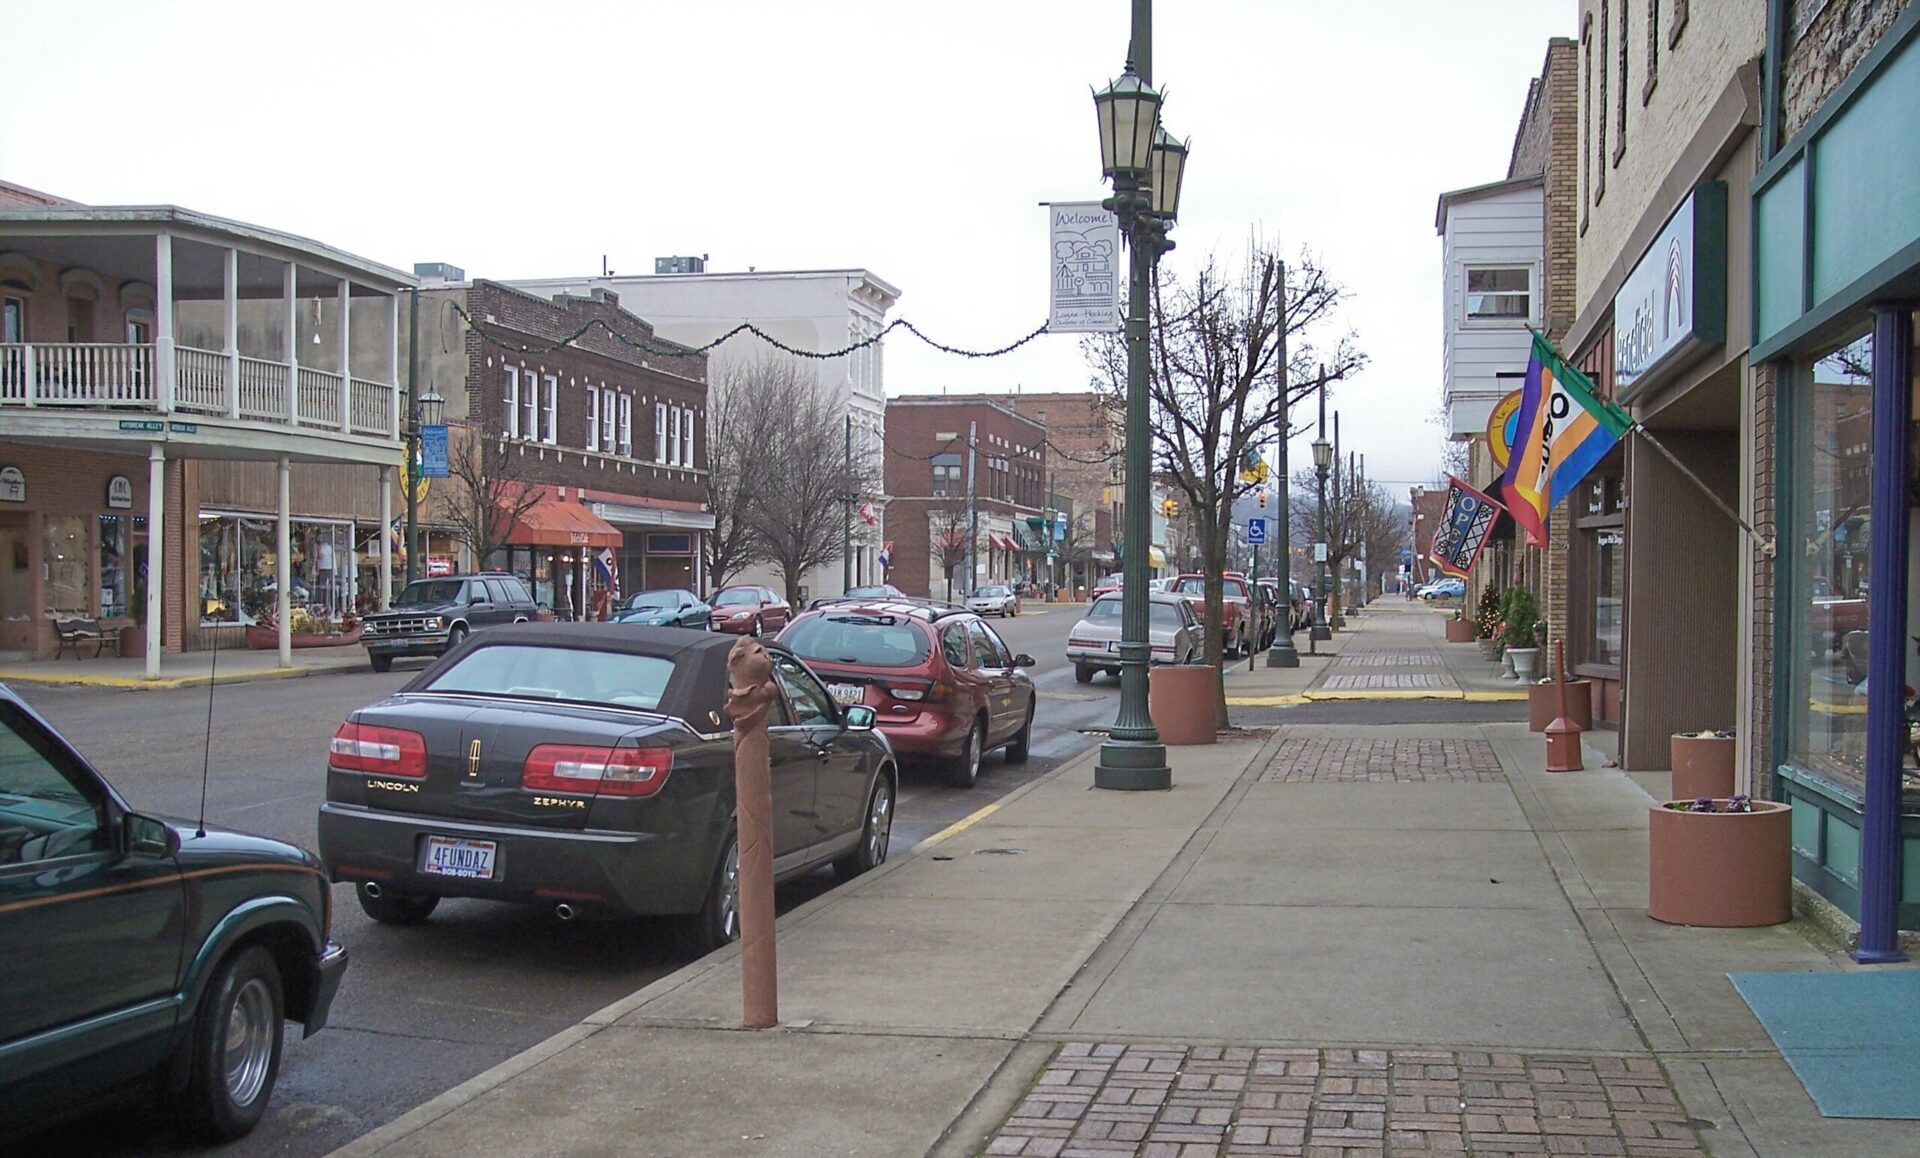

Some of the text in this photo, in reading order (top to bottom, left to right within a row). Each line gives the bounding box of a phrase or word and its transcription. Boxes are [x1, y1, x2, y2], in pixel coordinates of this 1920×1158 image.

[367, 779, 419, 793] LINCOLN
[533, 796, 586, 809] ZEPHYR
[434, 847, 489, 869] 4FUNDAZ
